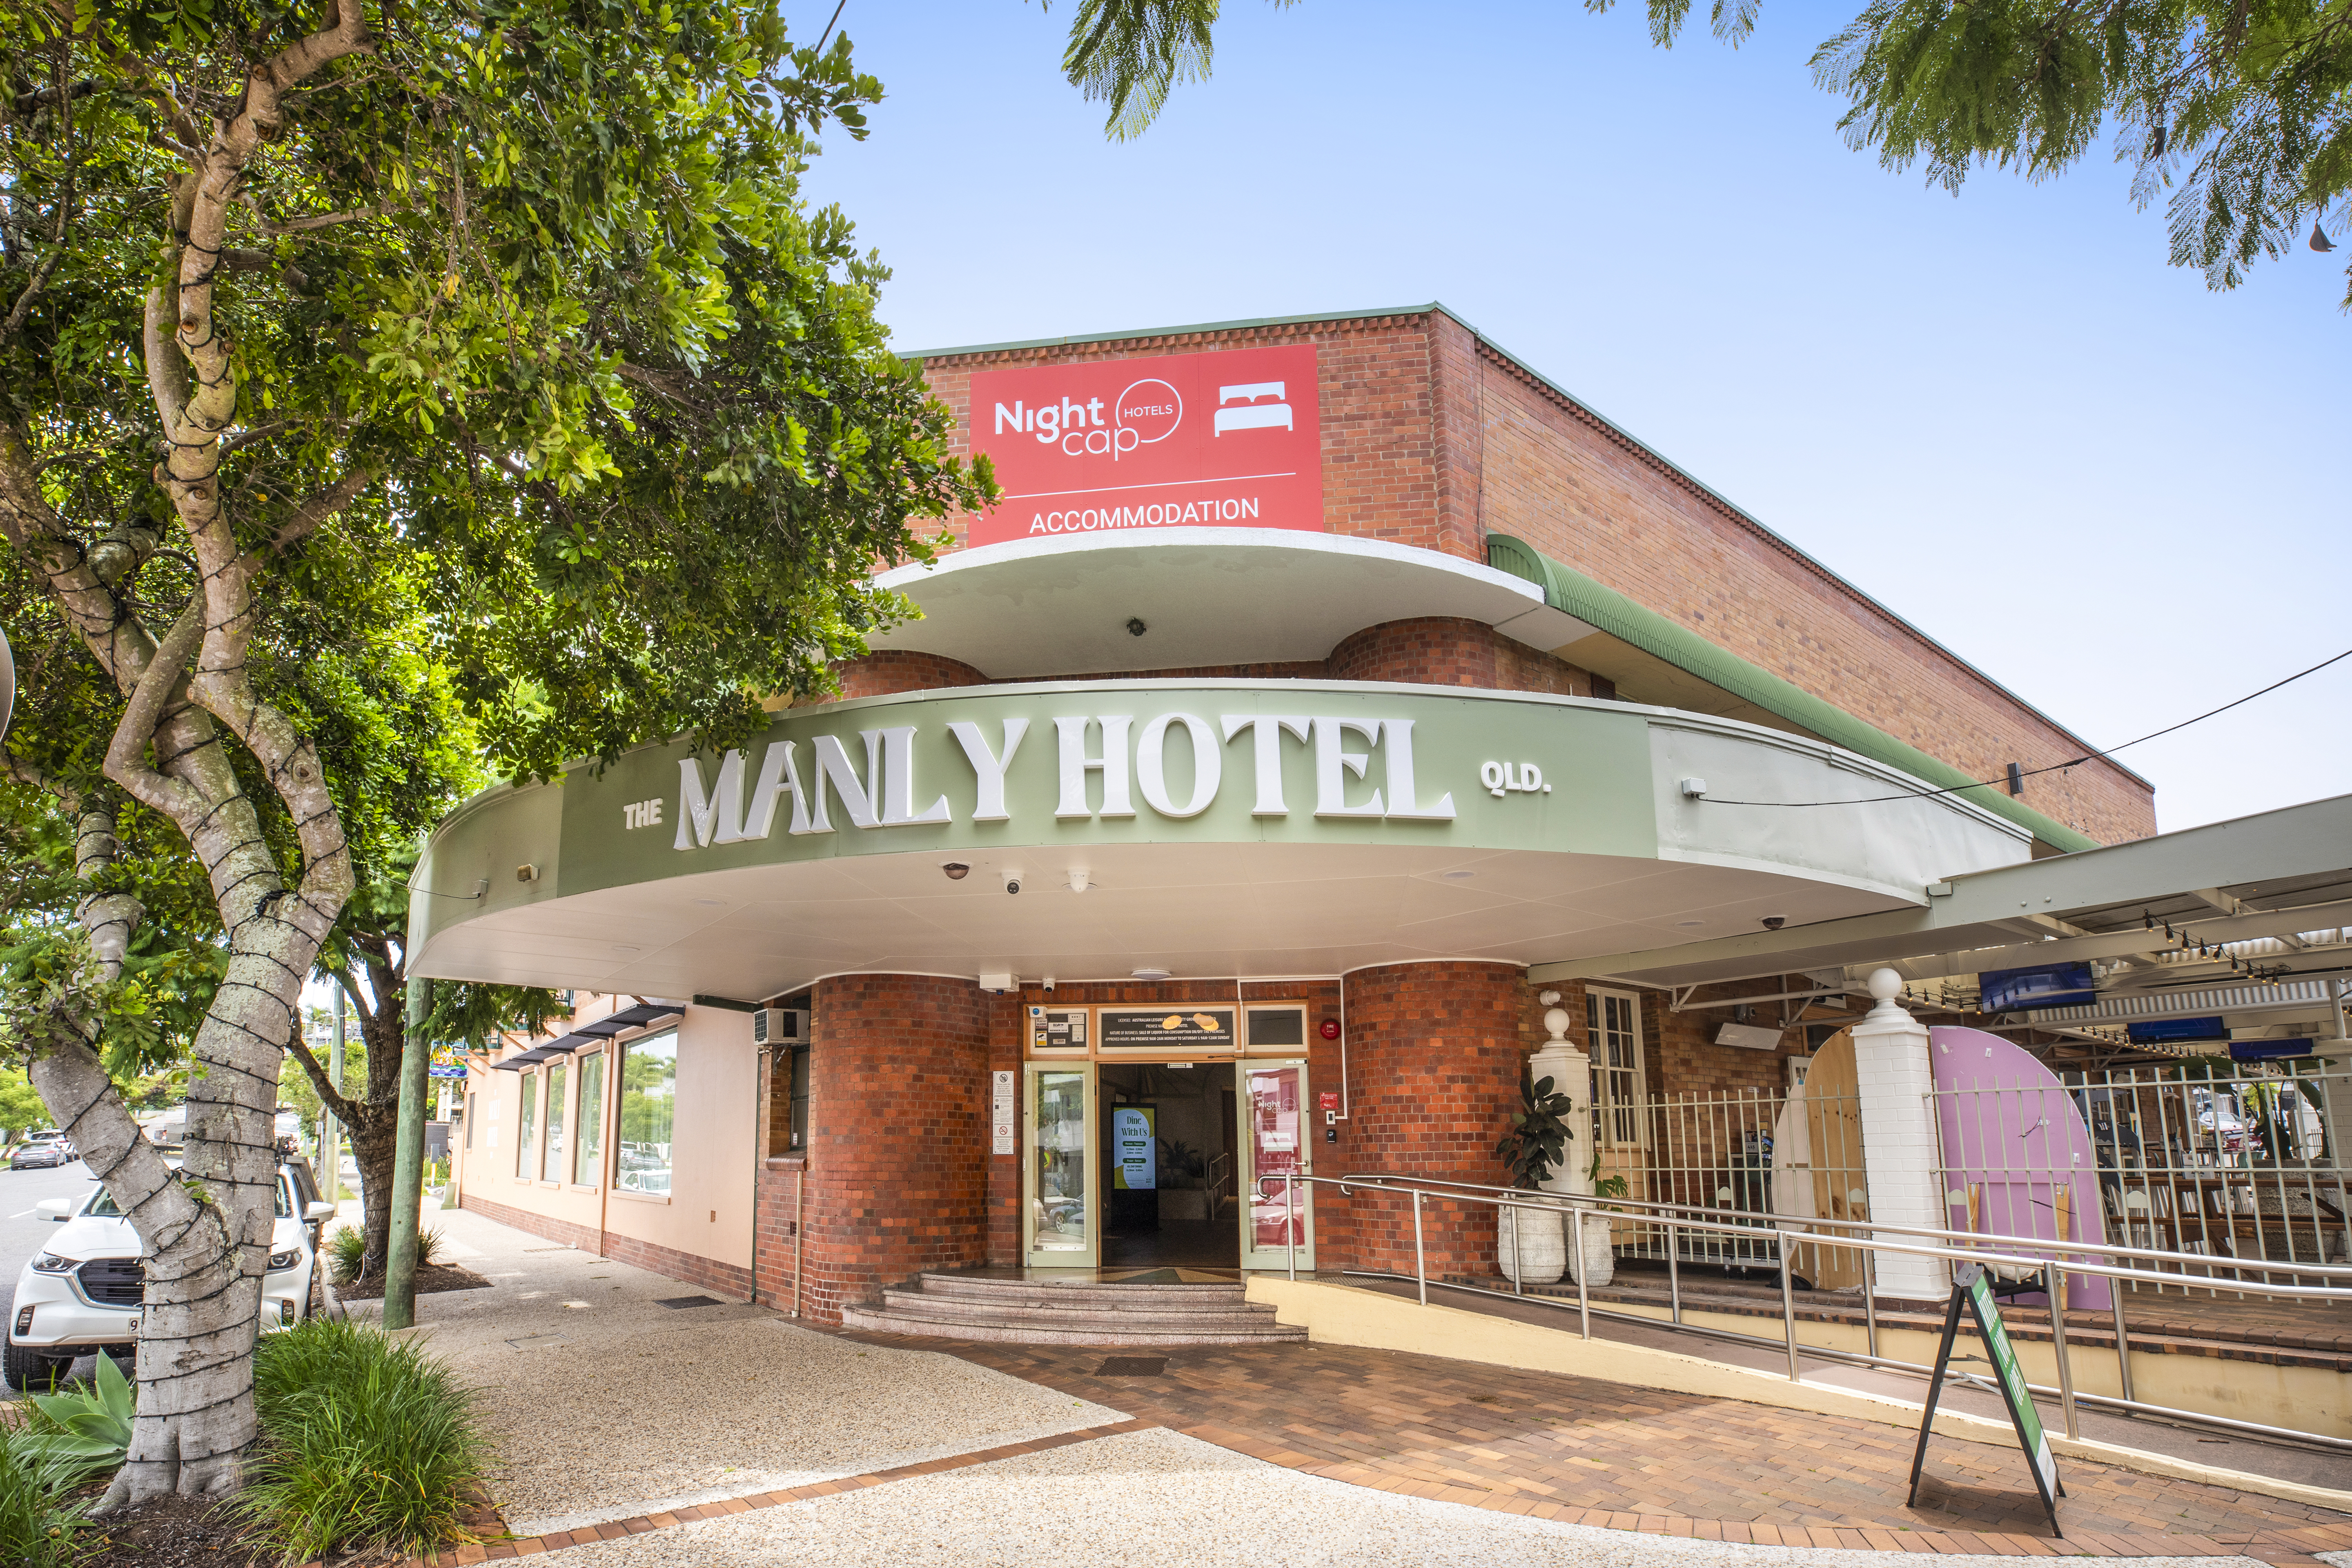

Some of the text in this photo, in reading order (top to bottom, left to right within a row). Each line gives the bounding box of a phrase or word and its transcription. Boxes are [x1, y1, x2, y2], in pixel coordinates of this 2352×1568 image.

[995, 396, 1173, 443] Night HOTELS
[1062, 427, 1139, 461] cap
[1029, 497, 1259, 534] ACCOMMODATION
[623, 711, 1552, 851] THE MANLY HOTEL QLD.
[1258, 1100, 1281, 1110] Night
[1272, 1107, 1287, 1115] cap
[1121, 1127, 1147, 1136] With Us
[1127, 1116, 1141, 1125] Dine
